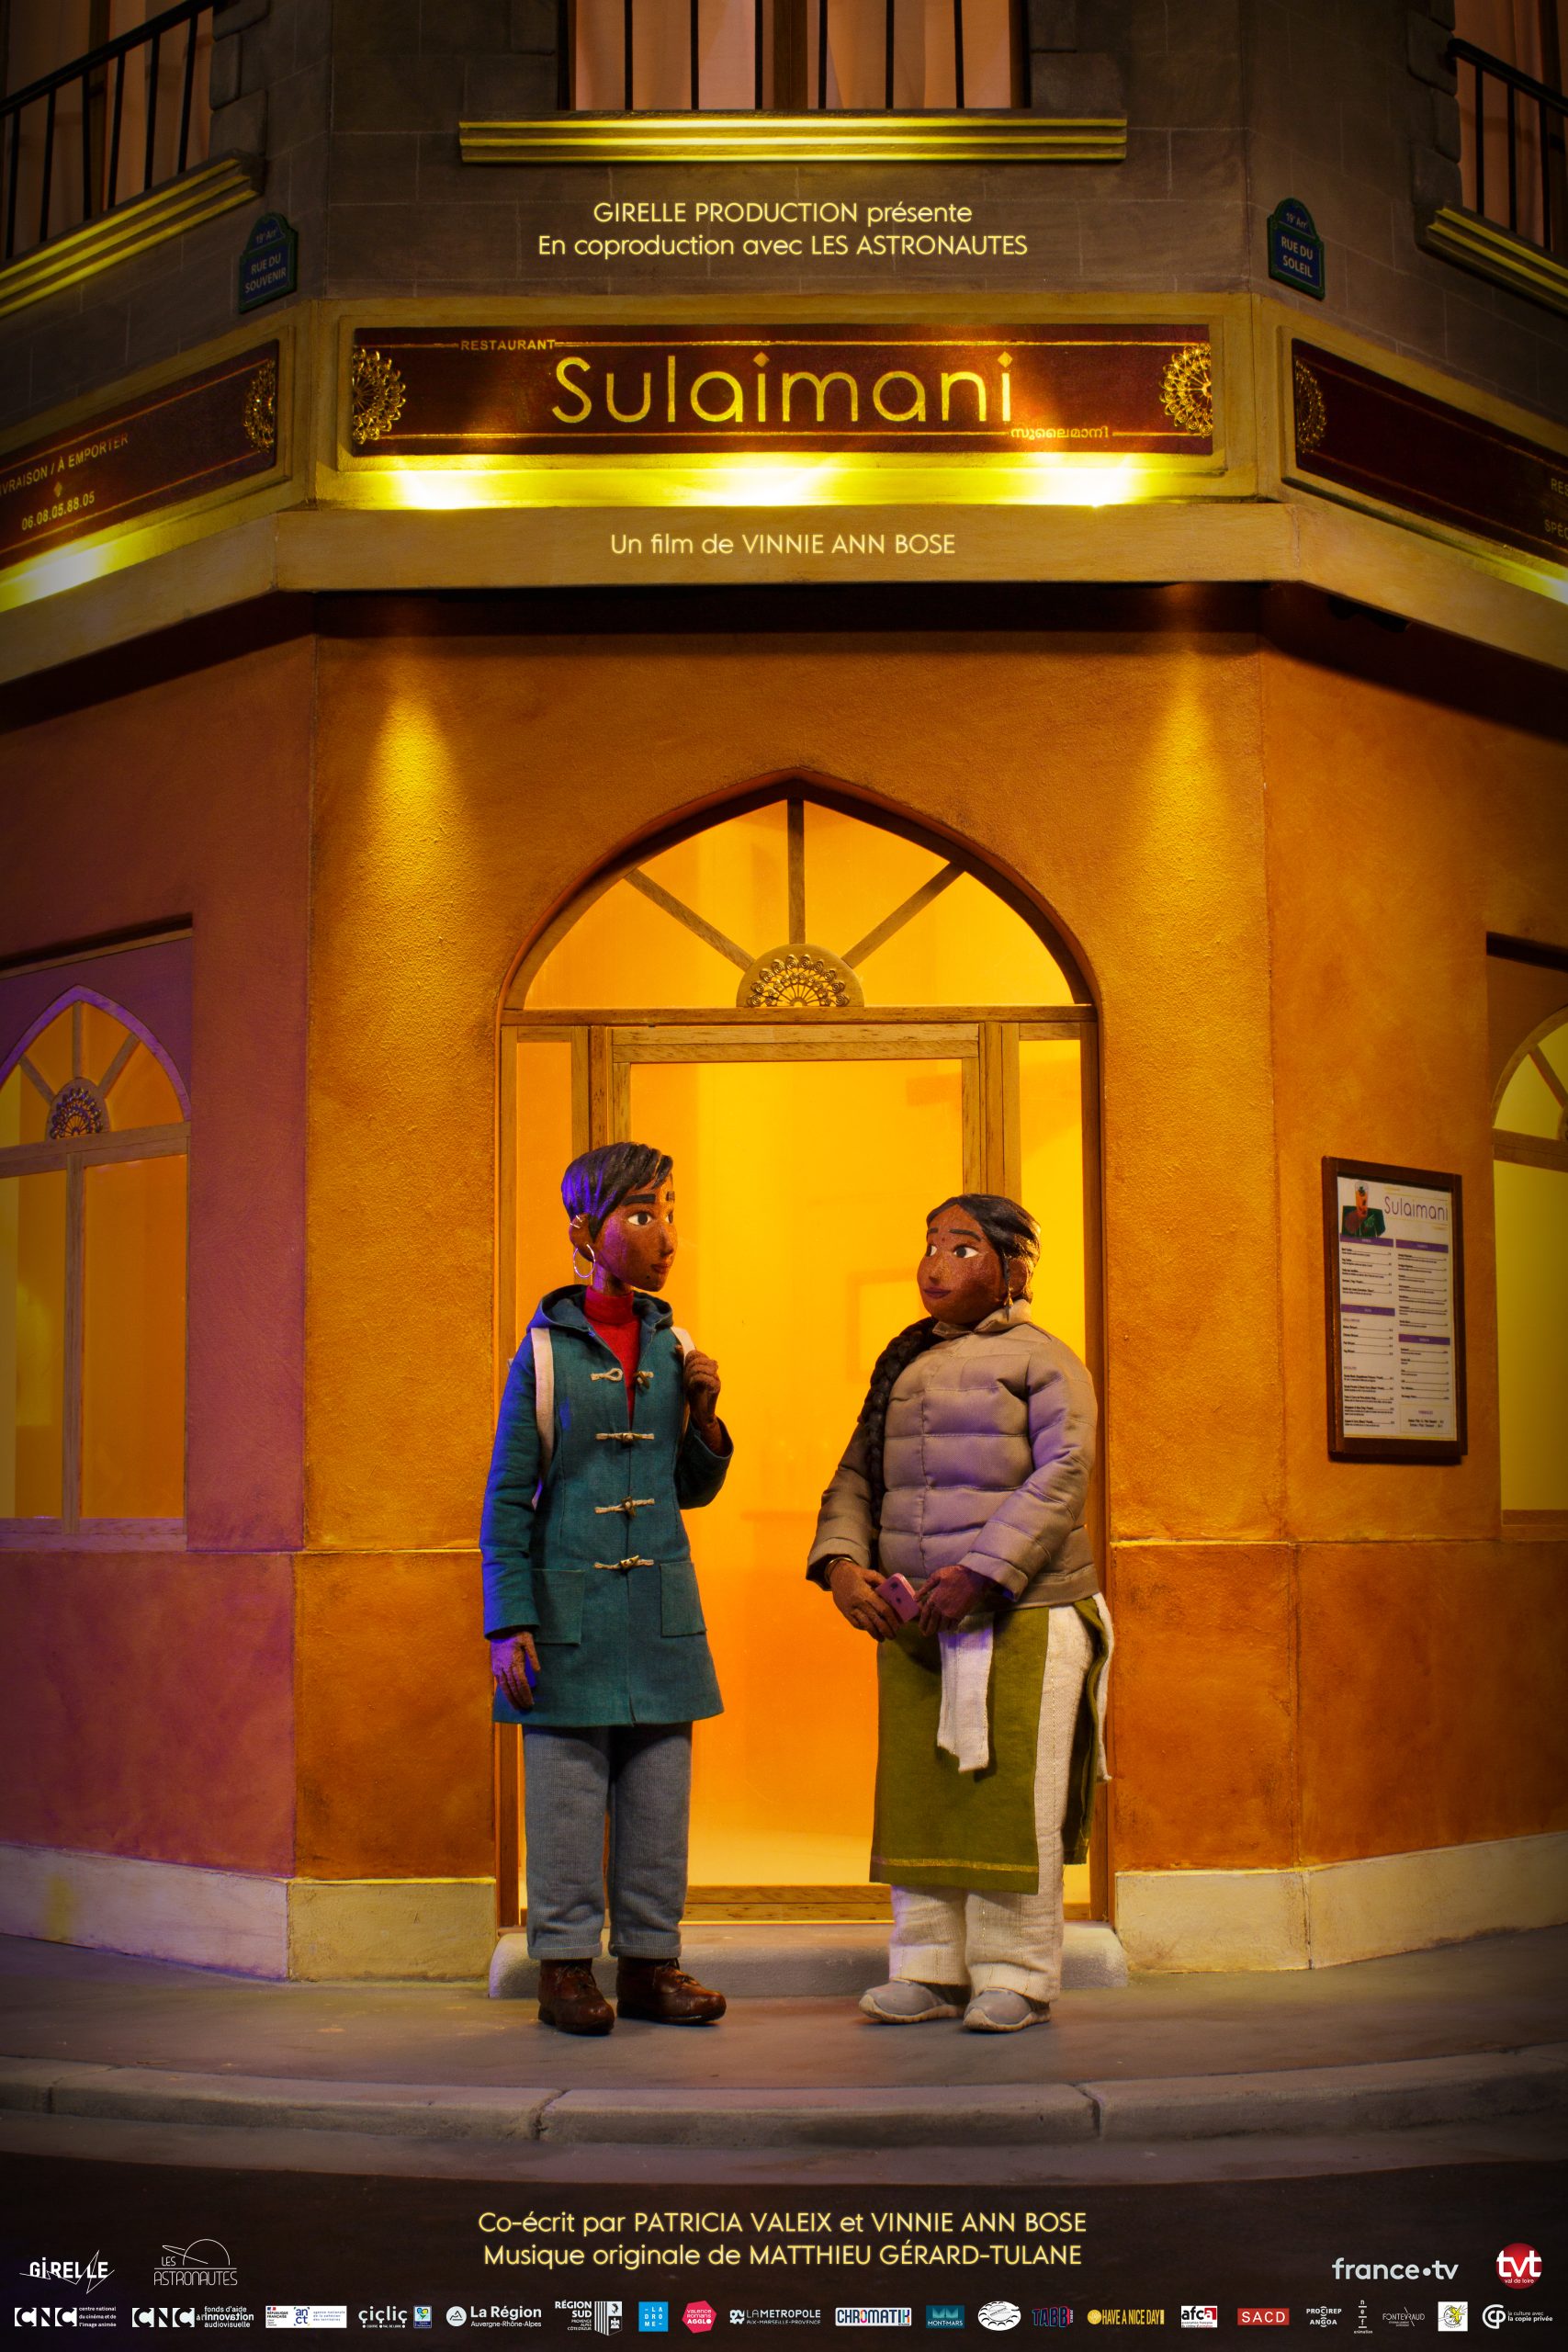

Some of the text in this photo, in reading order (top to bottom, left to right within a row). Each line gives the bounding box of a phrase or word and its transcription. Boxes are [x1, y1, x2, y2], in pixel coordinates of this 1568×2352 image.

[1281, 235, 1314, 261] RUE DU
[251, 253, 281, 276] RUE DU
[1282, 254, 1313, 278] SOLEIL
[244, 266, 287, 293] SOUVENIR
[461, 339, 556, 351] RESTAURANT
[551, 351, 1013, 424] Sulaimani
[68, 433, 129, 468] EMPORTER
[21, 490, 96, 531] 06.08.05.88.05
[1383, 1196, 1449, 1222] Sulaimani
